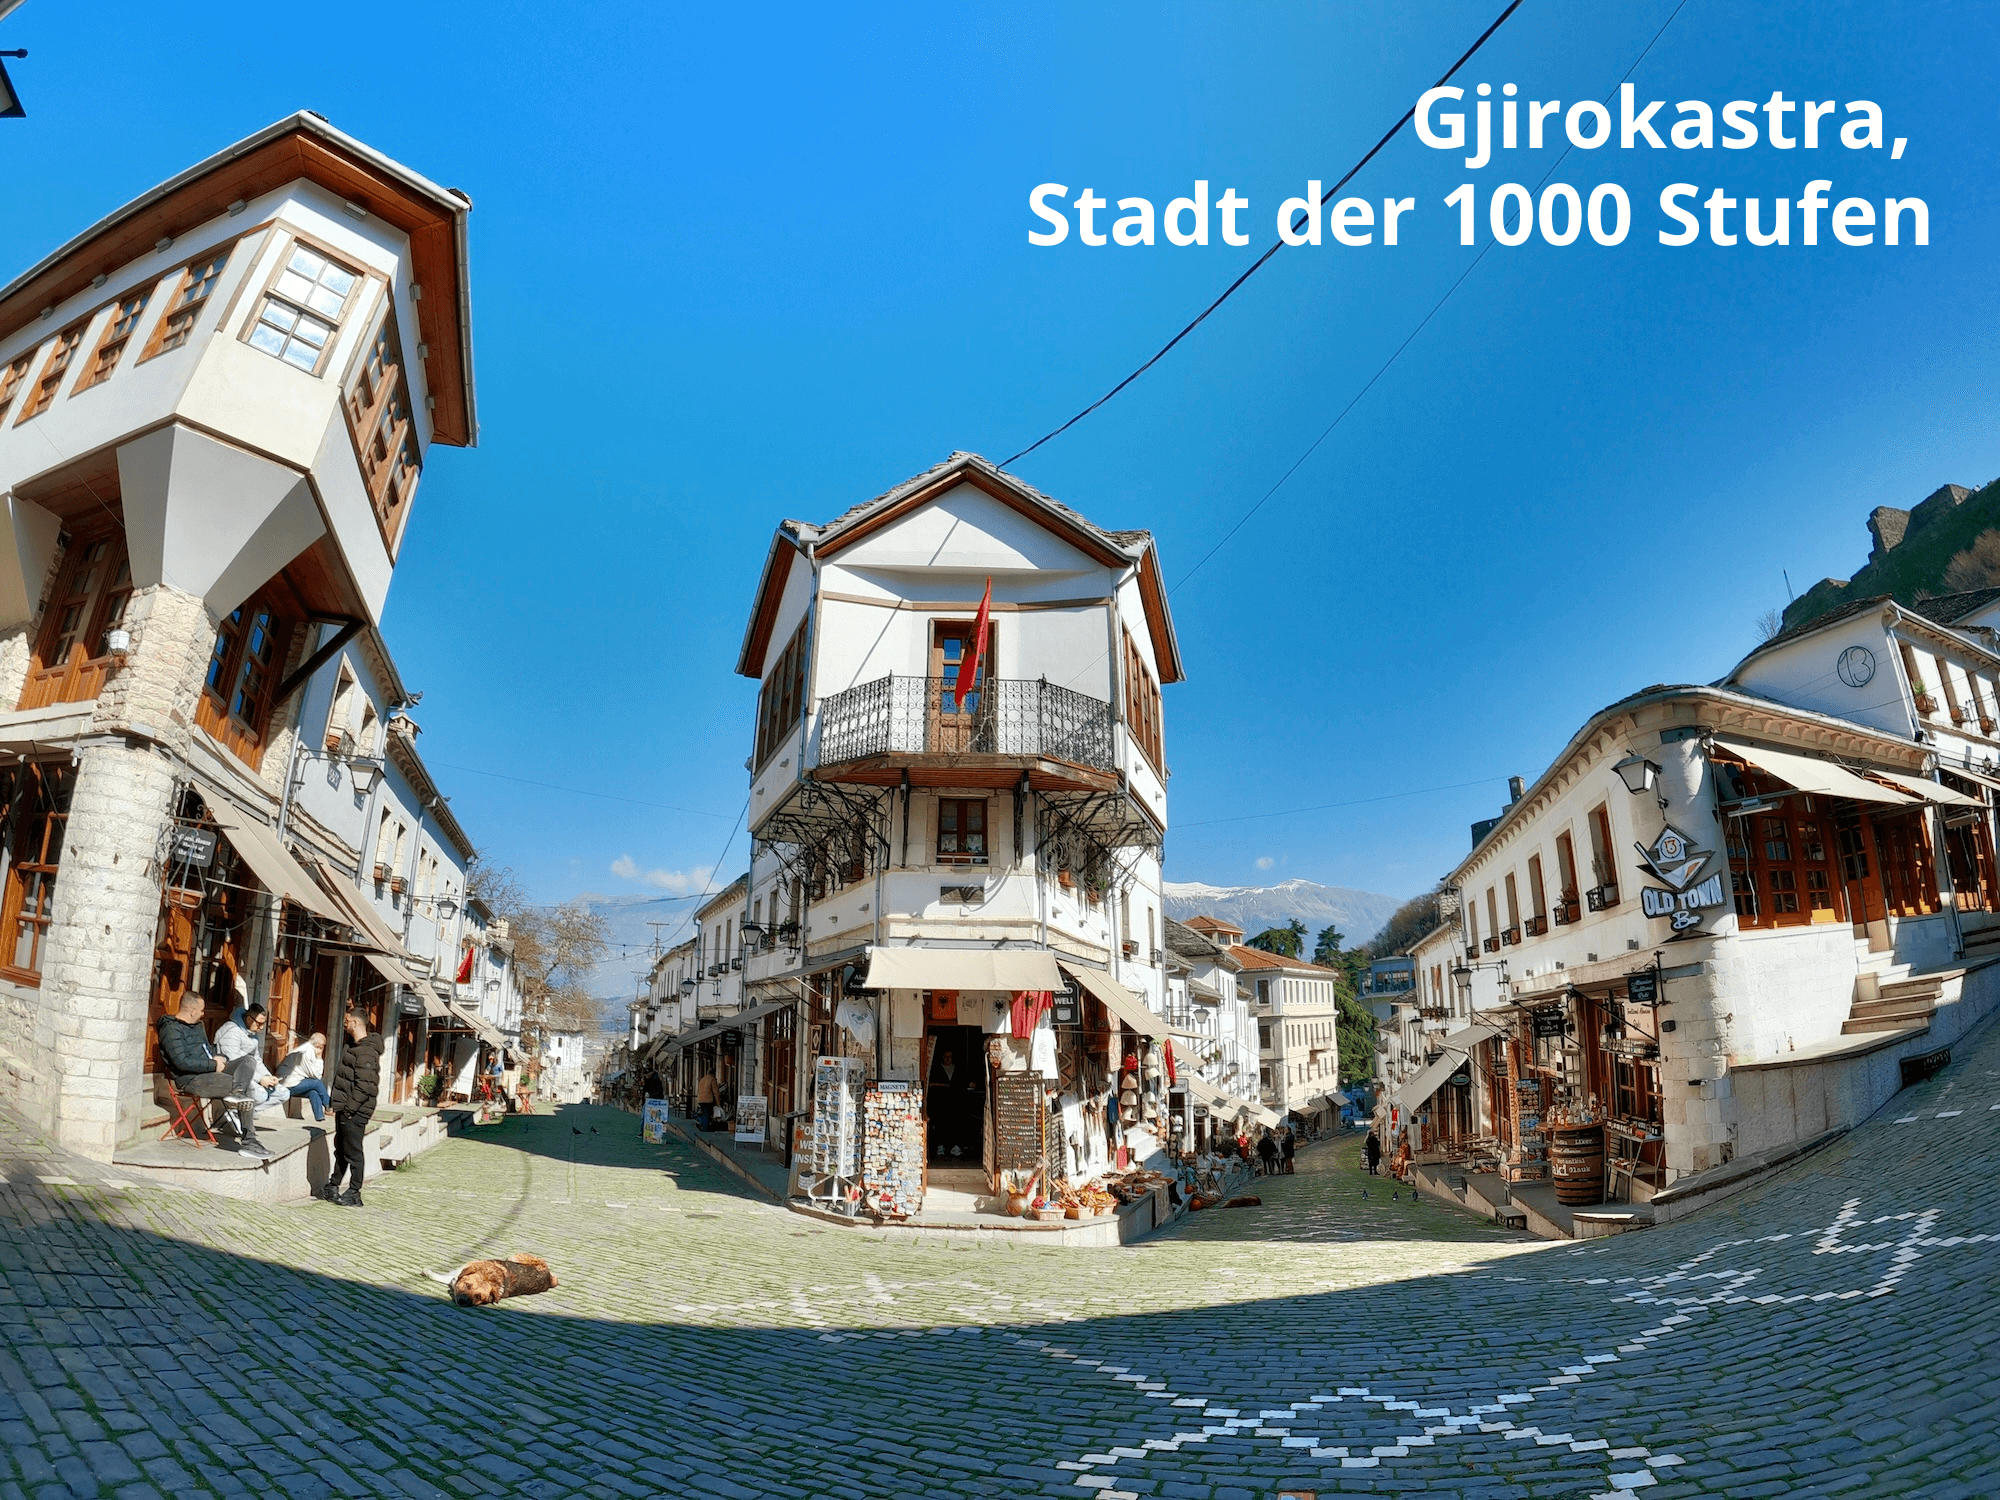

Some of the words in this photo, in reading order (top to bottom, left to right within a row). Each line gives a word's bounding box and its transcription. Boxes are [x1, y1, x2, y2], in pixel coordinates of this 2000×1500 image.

[1839, 646, 1871, 687] 13
[1642, 889, 1675, 916] OLD
[1677, 873, 1724, 911] TOWN
[1671, 910, 1701, 930] Bar
[1053, 996, 1074, 1005] WELL
